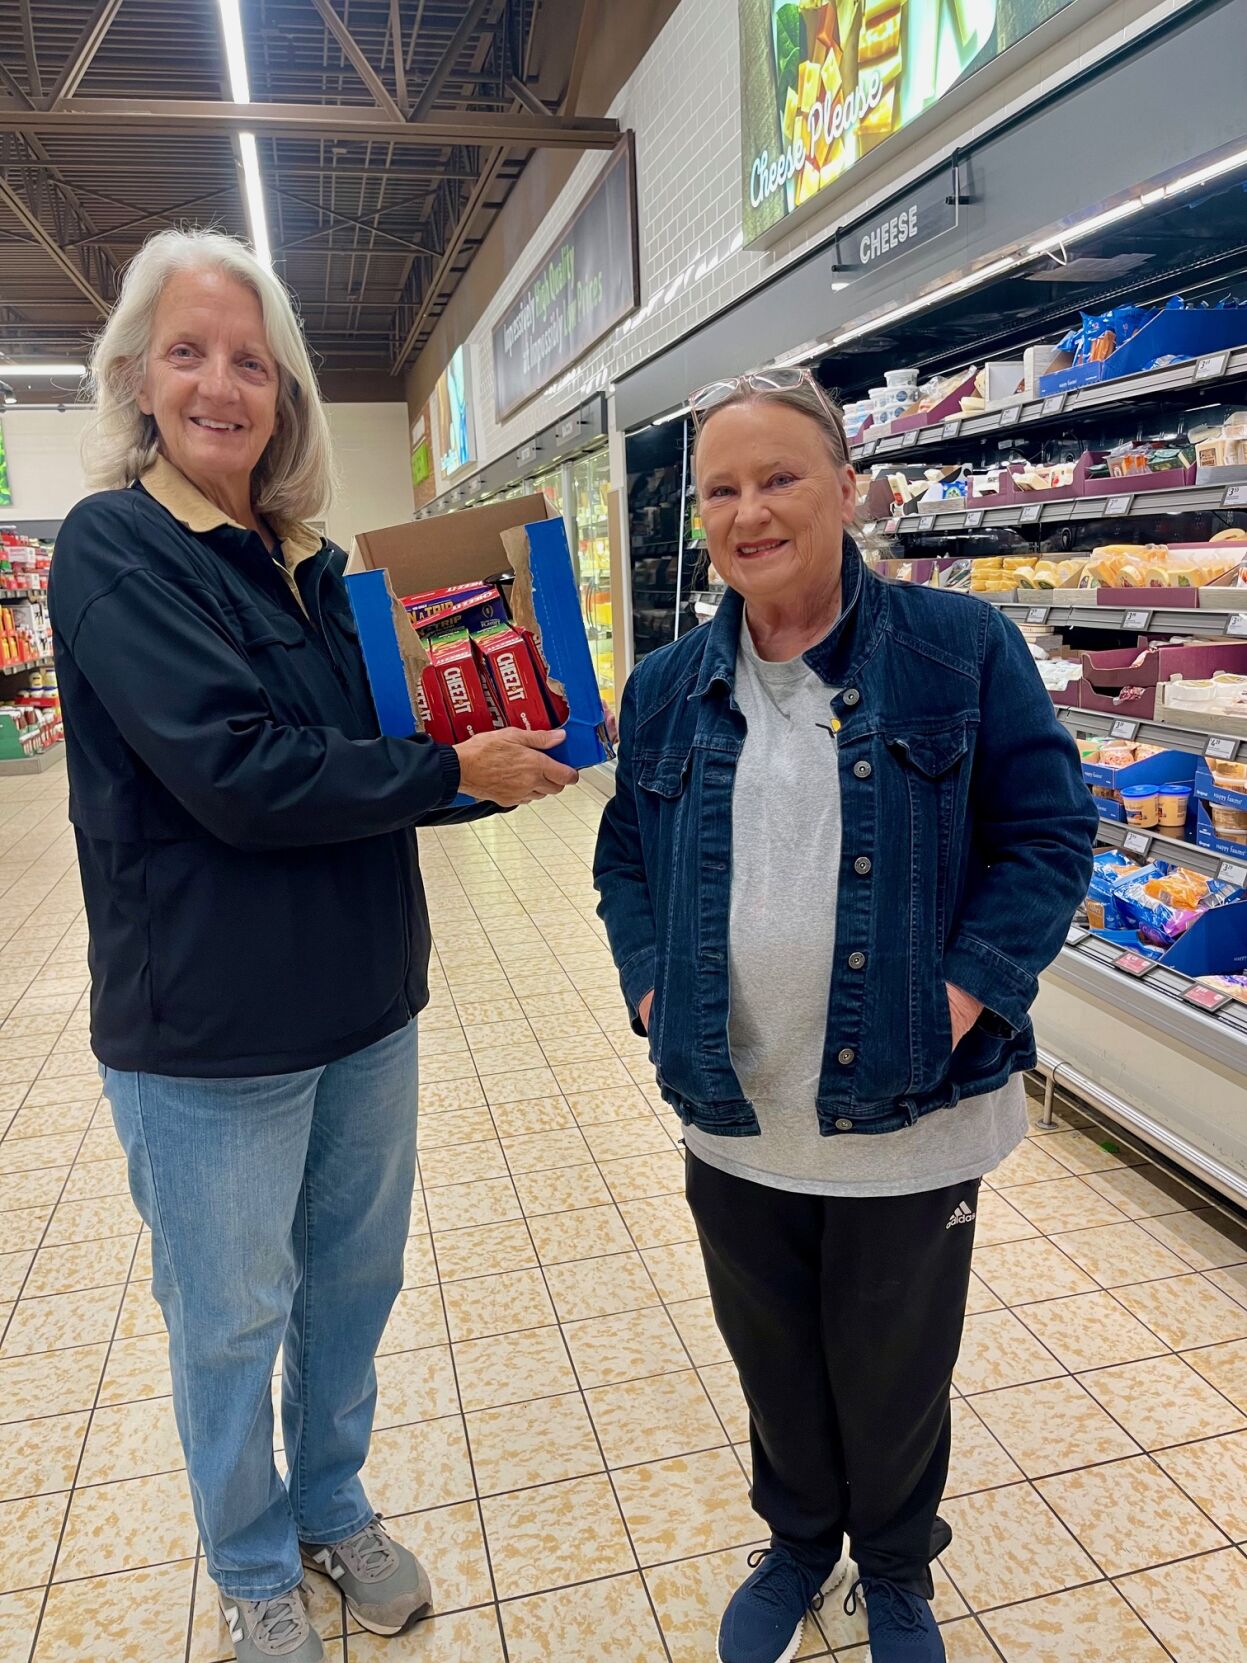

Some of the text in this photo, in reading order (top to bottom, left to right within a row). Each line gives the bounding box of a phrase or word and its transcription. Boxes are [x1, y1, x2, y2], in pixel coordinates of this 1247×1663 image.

[749, 72, 883, 208] Cheese Please
[859, 204, 918, 265] CHEESE
